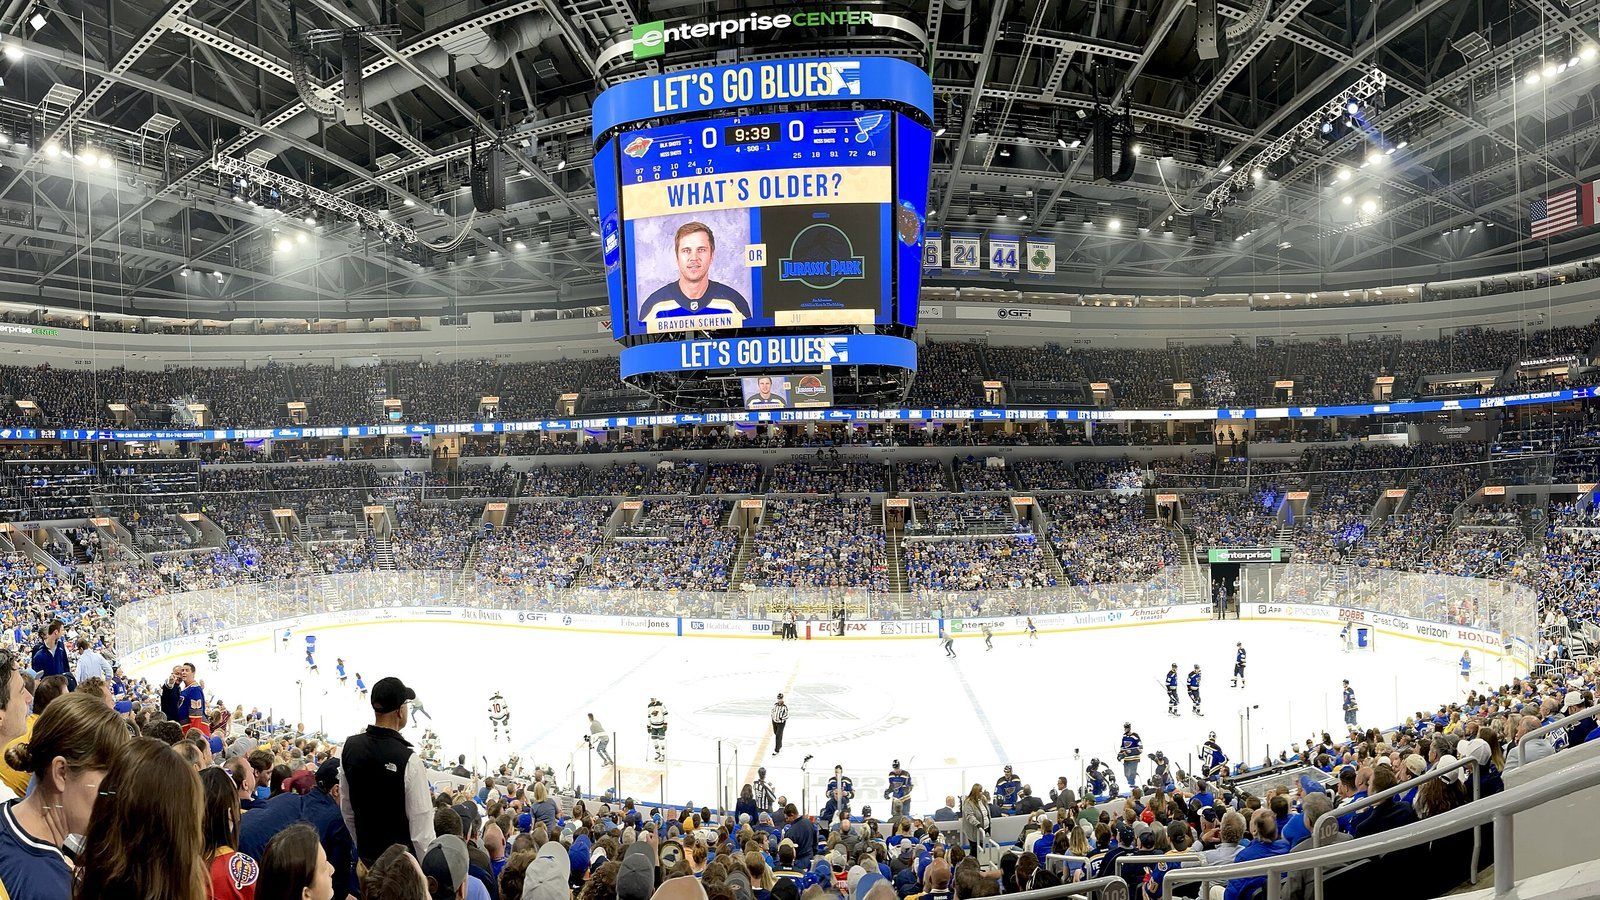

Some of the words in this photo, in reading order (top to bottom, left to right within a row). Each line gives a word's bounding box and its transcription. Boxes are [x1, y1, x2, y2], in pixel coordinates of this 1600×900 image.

[641, 12, 791, 47] enterprise
[793, 11, 873, 27] CENTER
[653, 73, 713, 112] LET'S
[723, 69, 753, 103] GO
[761, 62, 832, 98] BLUES
[702, 127, 717, 149] 0
[735, 126, 770, 142] 9:39
[788, 120, 804, 141] 0
[667, 178, 749, 207] WHAT'S
[760, 173, 842, 200] OLDER?
[749, 250, 763, 261] OR
[923, 245, 938, 266] 6
[954, 244, 977, 266] 24
[992, 247, 1018, 268] 44
[782, 261, 830, 279] JURASSIC
[830, 259, 862, 277] PARK
[658, 318, 695, 330] BRAYDEN
[697, 315, 732, 328] SCHENN
[682, 340, 727, 368] LET'S
[737, 339, 763, 364] GO
[768, 338, 826, 364] BLUES
[781, 411, 794, 420] LET'S
[795, 411, 802, 420] GO
[871, 410, 878, 418] GO
[945, 410, 952, 418] GO
[1020, 410, 1026, 419] GO
[1219, 551, 1271, 560] enterprise
[1130, 606, 1171, 616] Schnucks
[1339, 608, 1364, 620] DOBBS
[648, 620, 669, 628] Jones
[1073, 614, 1106, 624] Anthem
[1372, 614, 1391, 625] Great
[1392, 618, 1409, 630] Clips
[896, 622, 933, 634] STIFEL
[1416, 624, 1448, 639] verizon
[1458, 630, 1501, 647] HONDA
[492, 704, 500, 713] 10
[1319, 823, 1339, 839] 102
[1104, 887, 1127, 900] 103
